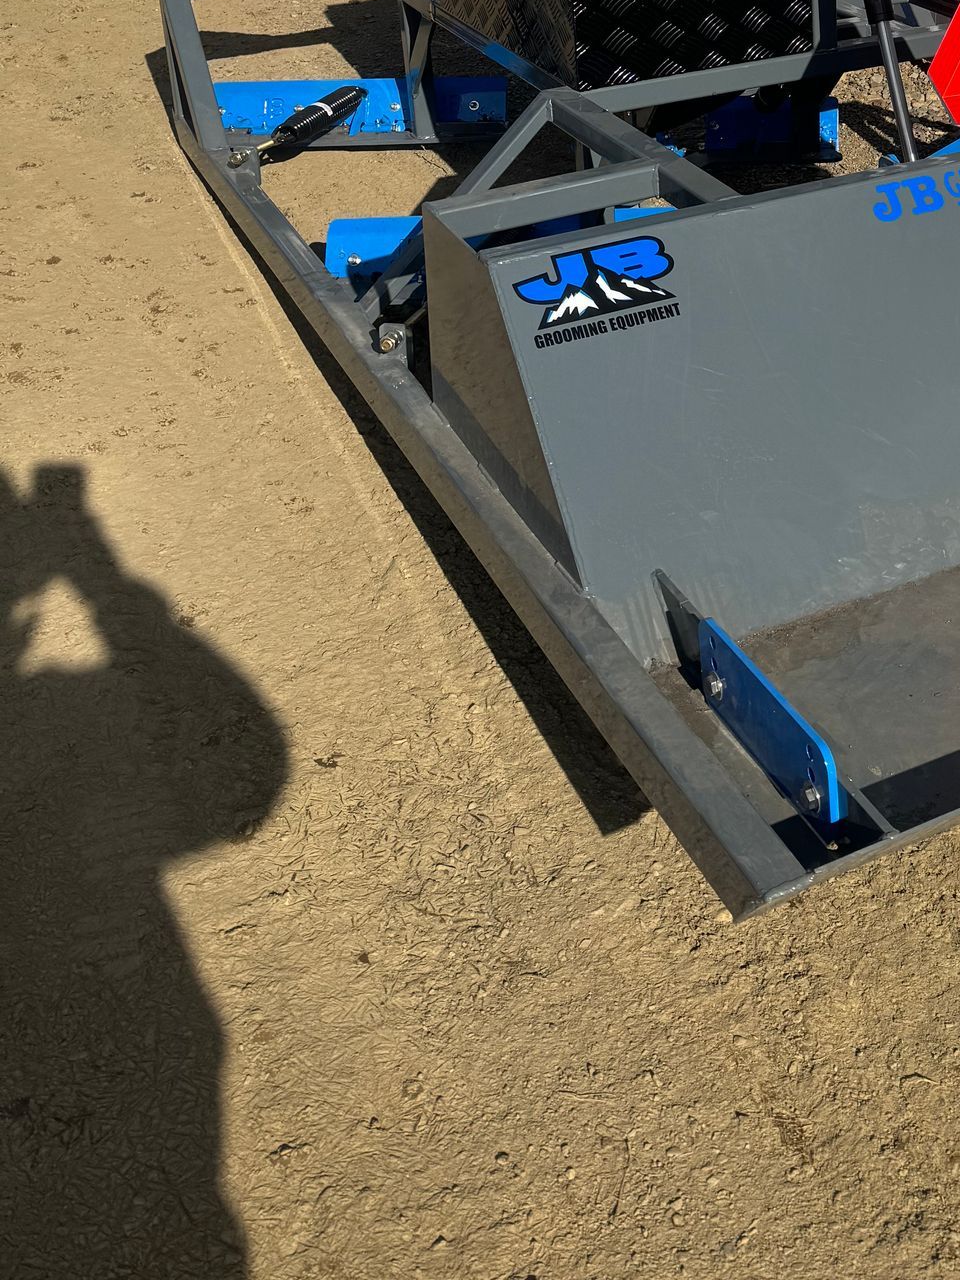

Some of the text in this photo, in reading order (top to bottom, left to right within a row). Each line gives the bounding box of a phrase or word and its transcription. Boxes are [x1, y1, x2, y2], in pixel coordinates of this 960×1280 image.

[873, 176, 945, 222] JB
[512, 236, 674, 304] JB
[533, 303, 681, 349] GROOMING EQUIPMENT
